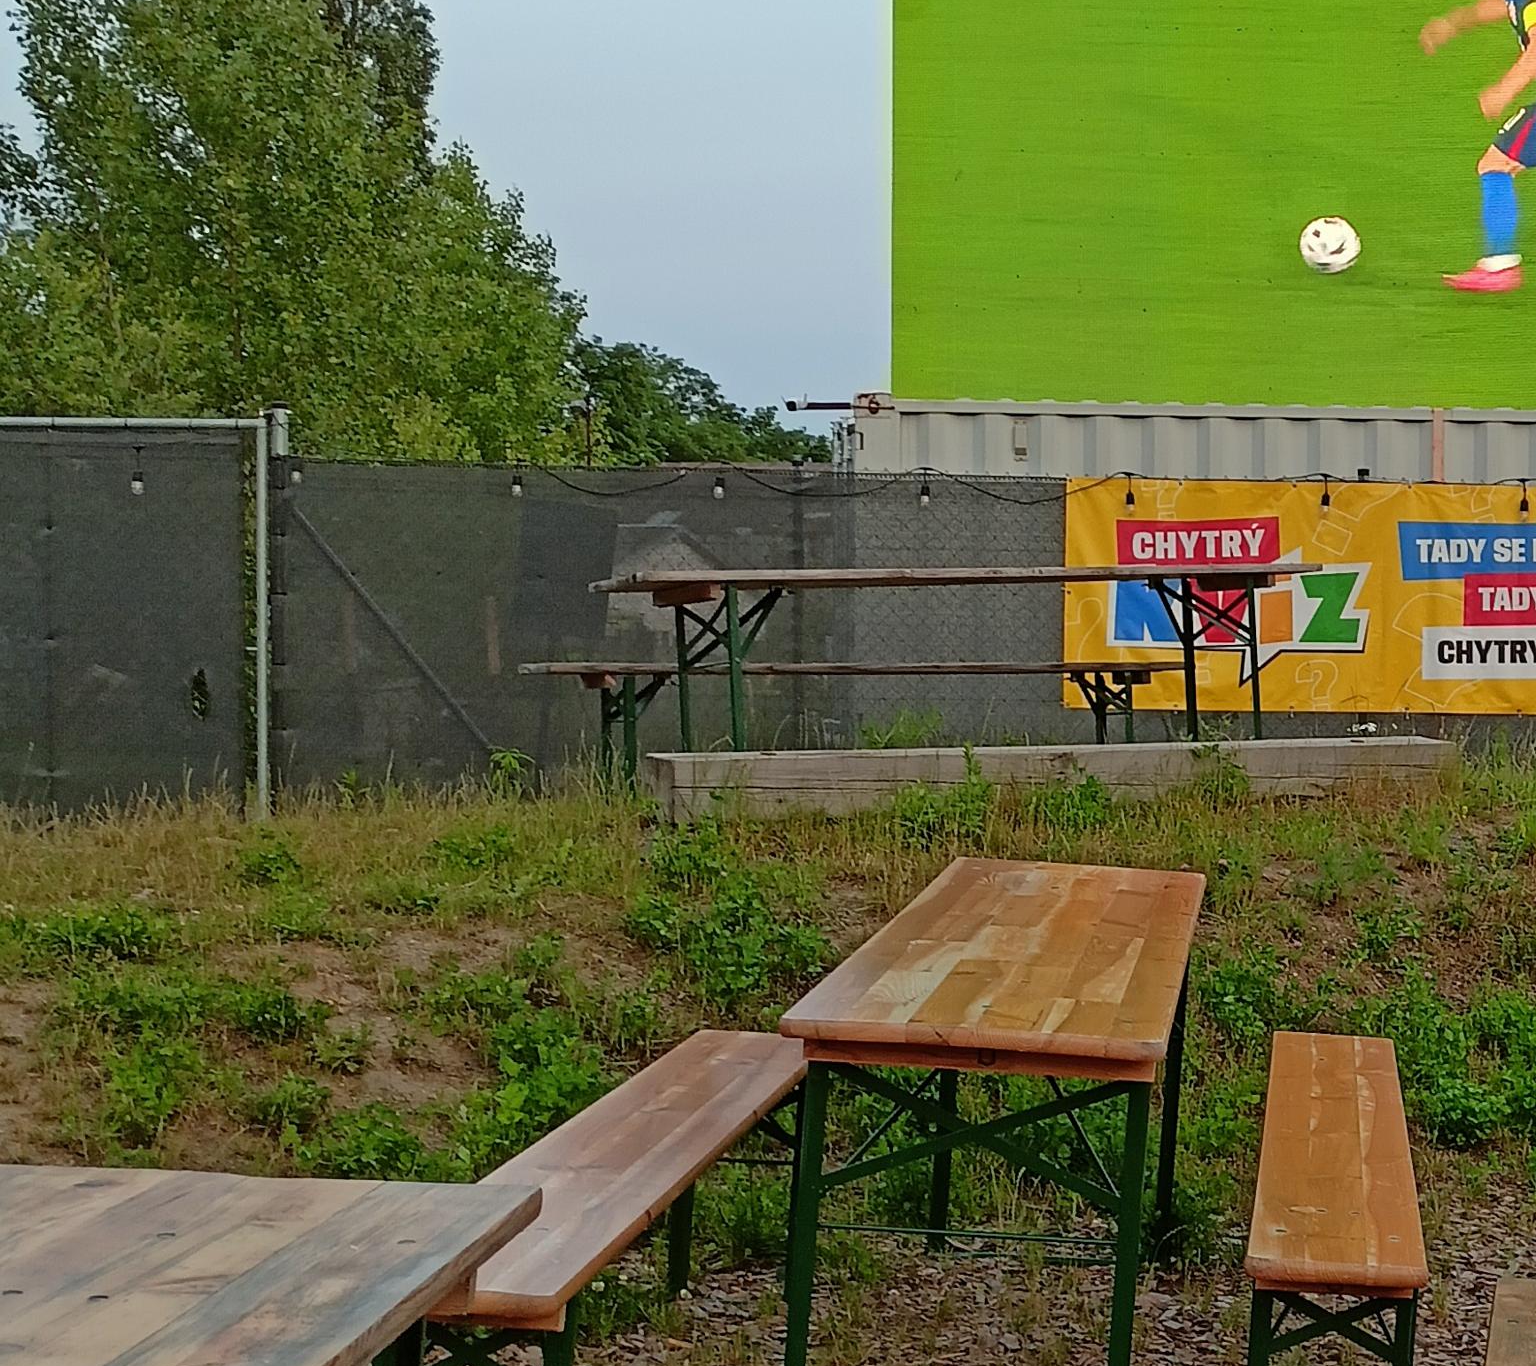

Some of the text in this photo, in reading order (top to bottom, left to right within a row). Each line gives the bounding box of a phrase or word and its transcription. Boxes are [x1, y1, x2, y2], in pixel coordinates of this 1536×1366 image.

[1131, 523, 1265, 560] CHYTRÝ
[1416, 538, 1485, 564] TADY
[1493, 538, 1527, 563] SE
